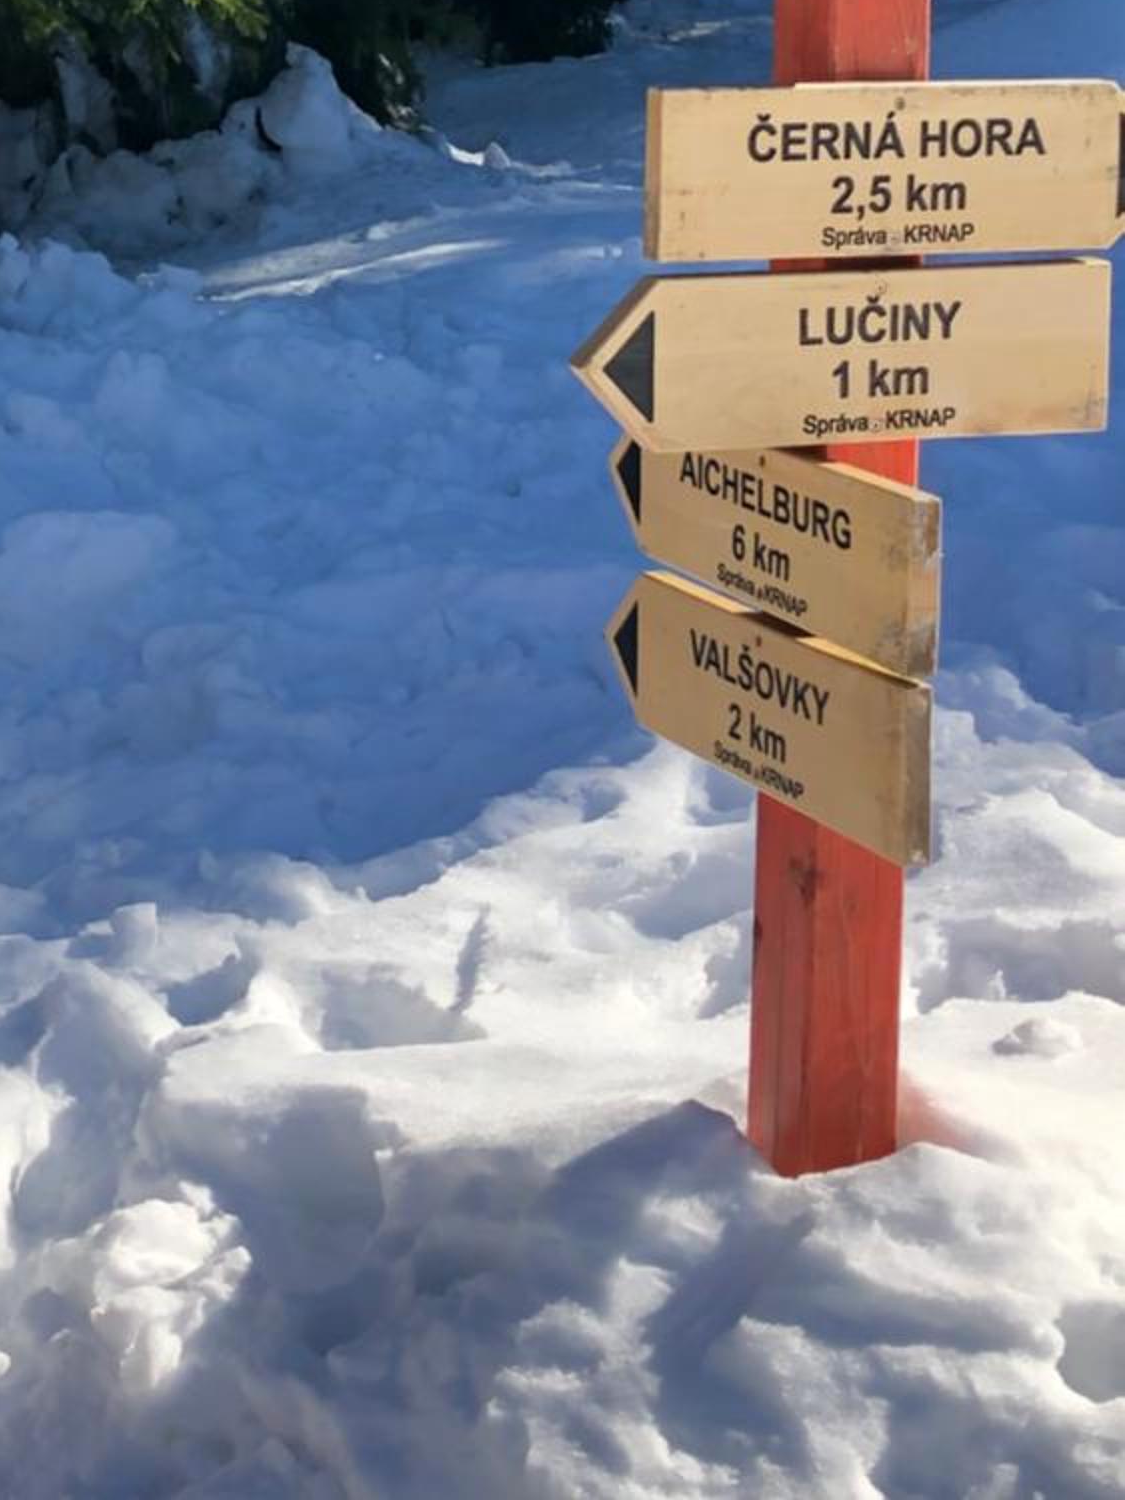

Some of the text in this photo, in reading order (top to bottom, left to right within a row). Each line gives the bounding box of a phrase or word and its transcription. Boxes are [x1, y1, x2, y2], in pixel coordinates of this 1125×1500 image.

[747, 112, 1046, 163] ČERNÁ HORA
[831, 174, 966, 221] 2,5 km
[821, 222, 975, 250] Správa KRNAP
[798, 295, 961, 346] LUČINY
[832, 359, 930, 399] 1 km
[802, 407, 956, 437] Správa KRNAP
[679, 450, 853, 550] AICHELBURG
[731, 523, 790, 582] 6 km
[716, 562, 808, 617] Správa KRNAP
[689, 627, 830, 726] VALŠOVKY
[727, 702, 787, 764] 2 km
[713, 739, 805, 801] Správa KRNAP
